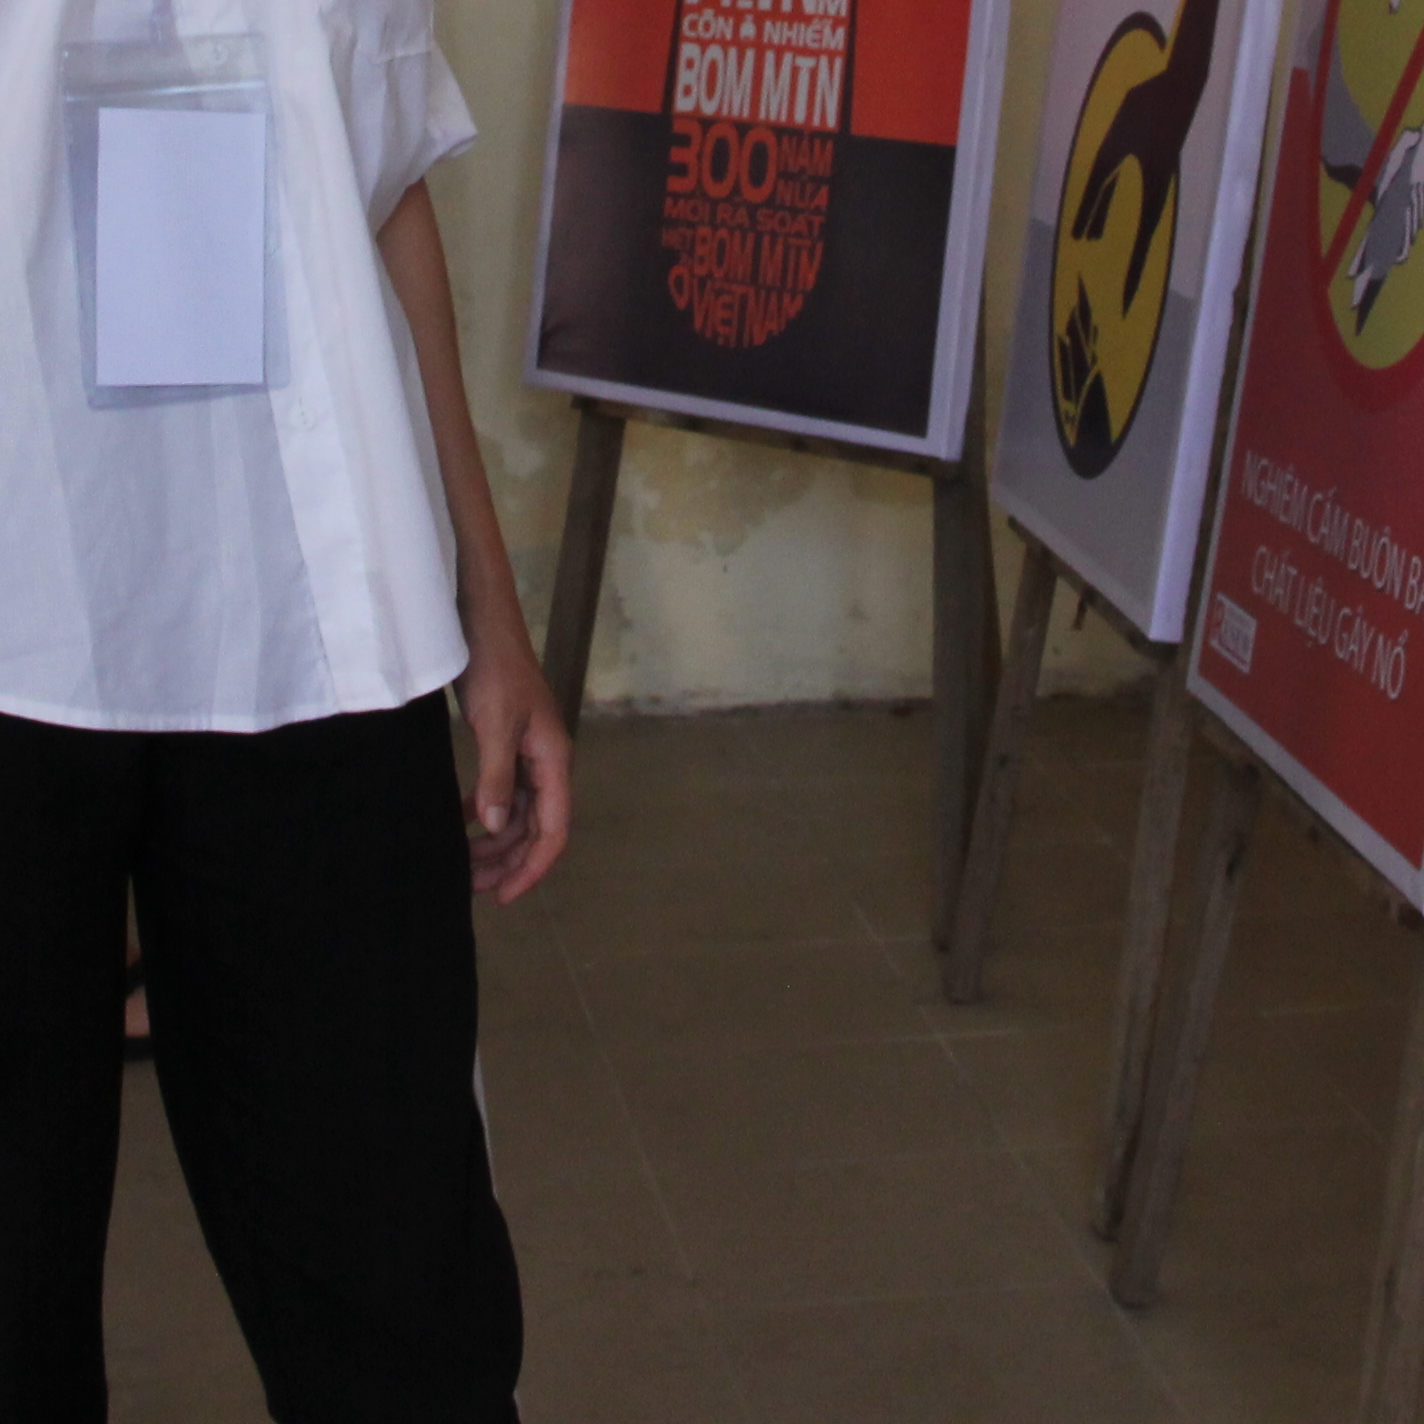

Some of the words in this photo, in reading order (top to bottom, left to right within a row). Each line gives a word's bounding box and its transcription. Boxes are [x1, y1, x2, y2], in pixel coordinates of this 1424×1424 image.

[675, 41, 756, 120] BOM
[666, 118, 778, 204] 300
[694, 226, 756, 284] BOM
